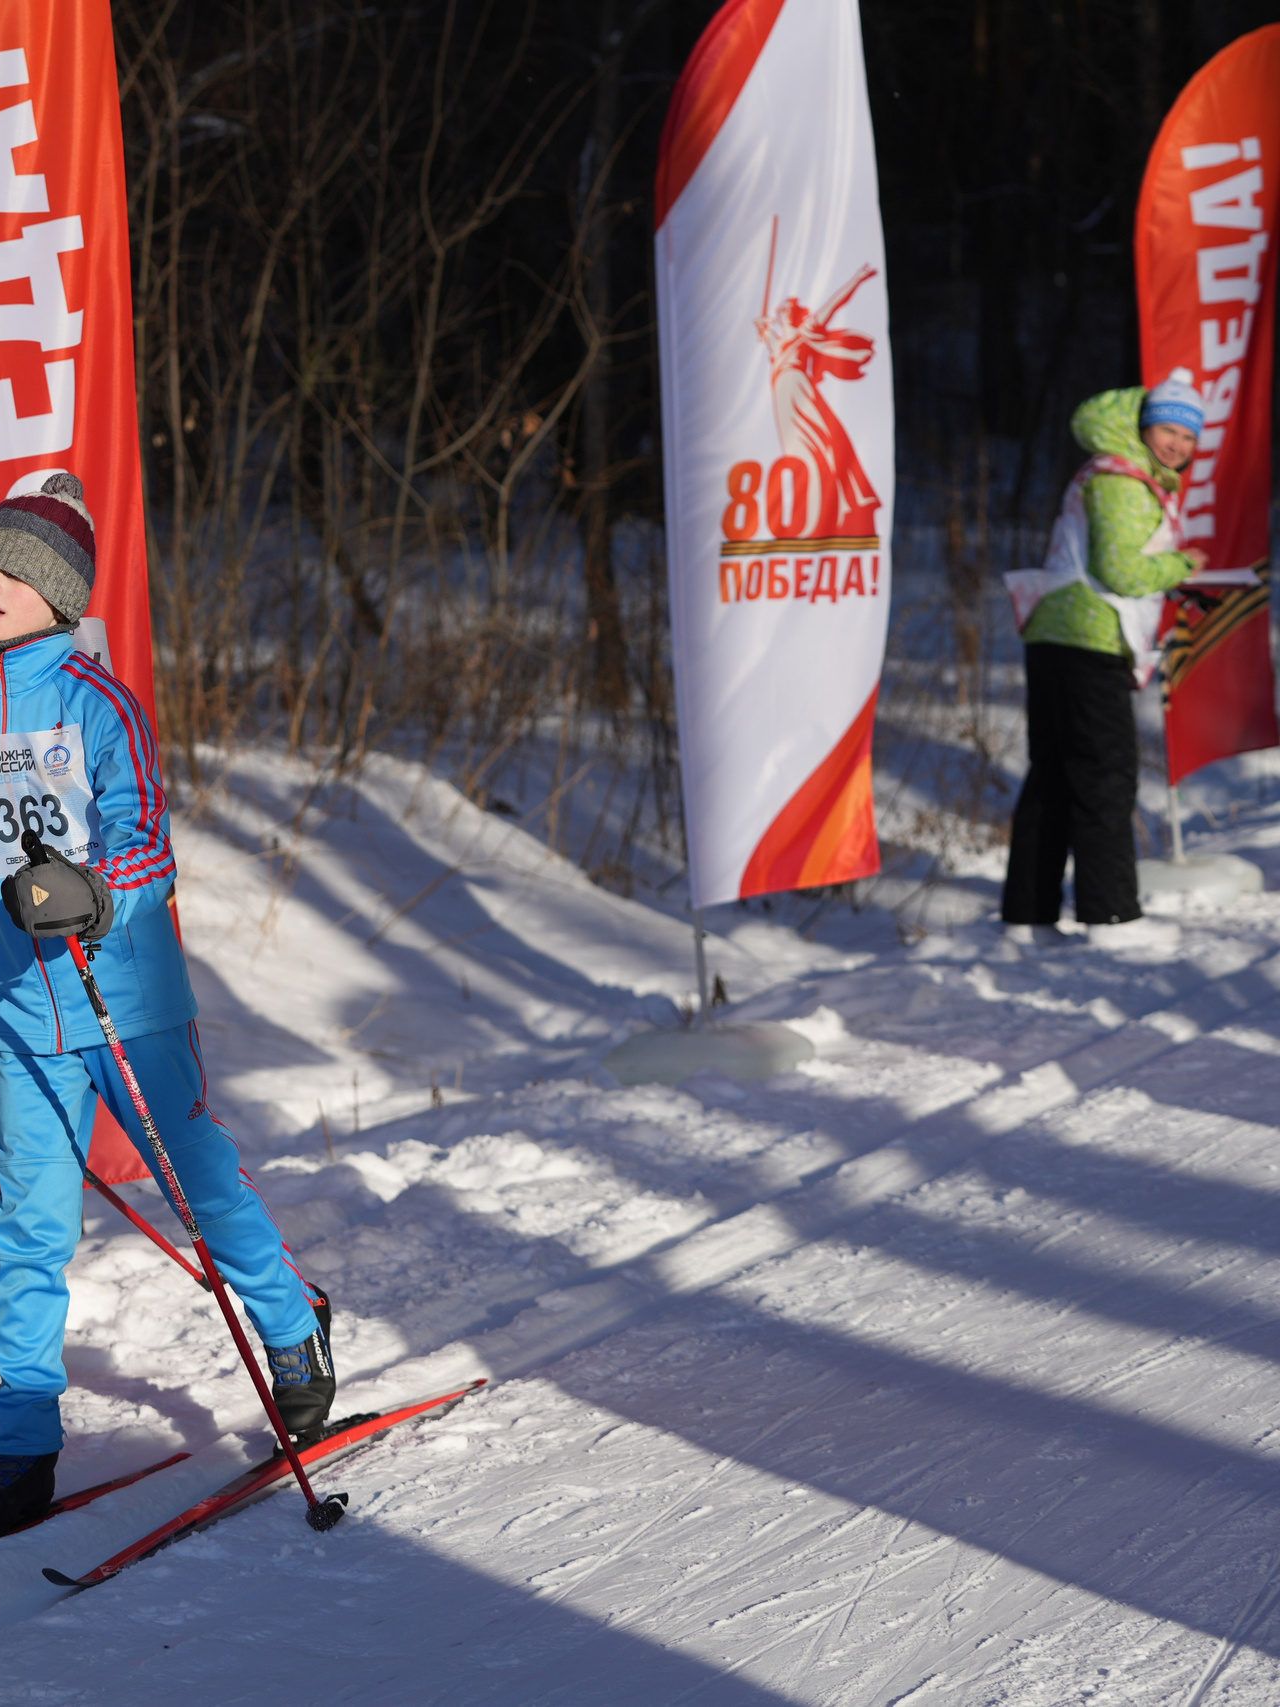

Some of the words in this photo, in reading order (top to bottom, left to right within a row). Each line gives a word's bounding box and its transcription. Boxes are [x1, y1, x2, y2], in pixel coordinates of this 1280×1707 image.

[722, 455, 810, 542] 80
[719, 556, 880, 604] ПОБЕДА!
[64, 841, 99, 857] ОБЛАСТЬ
